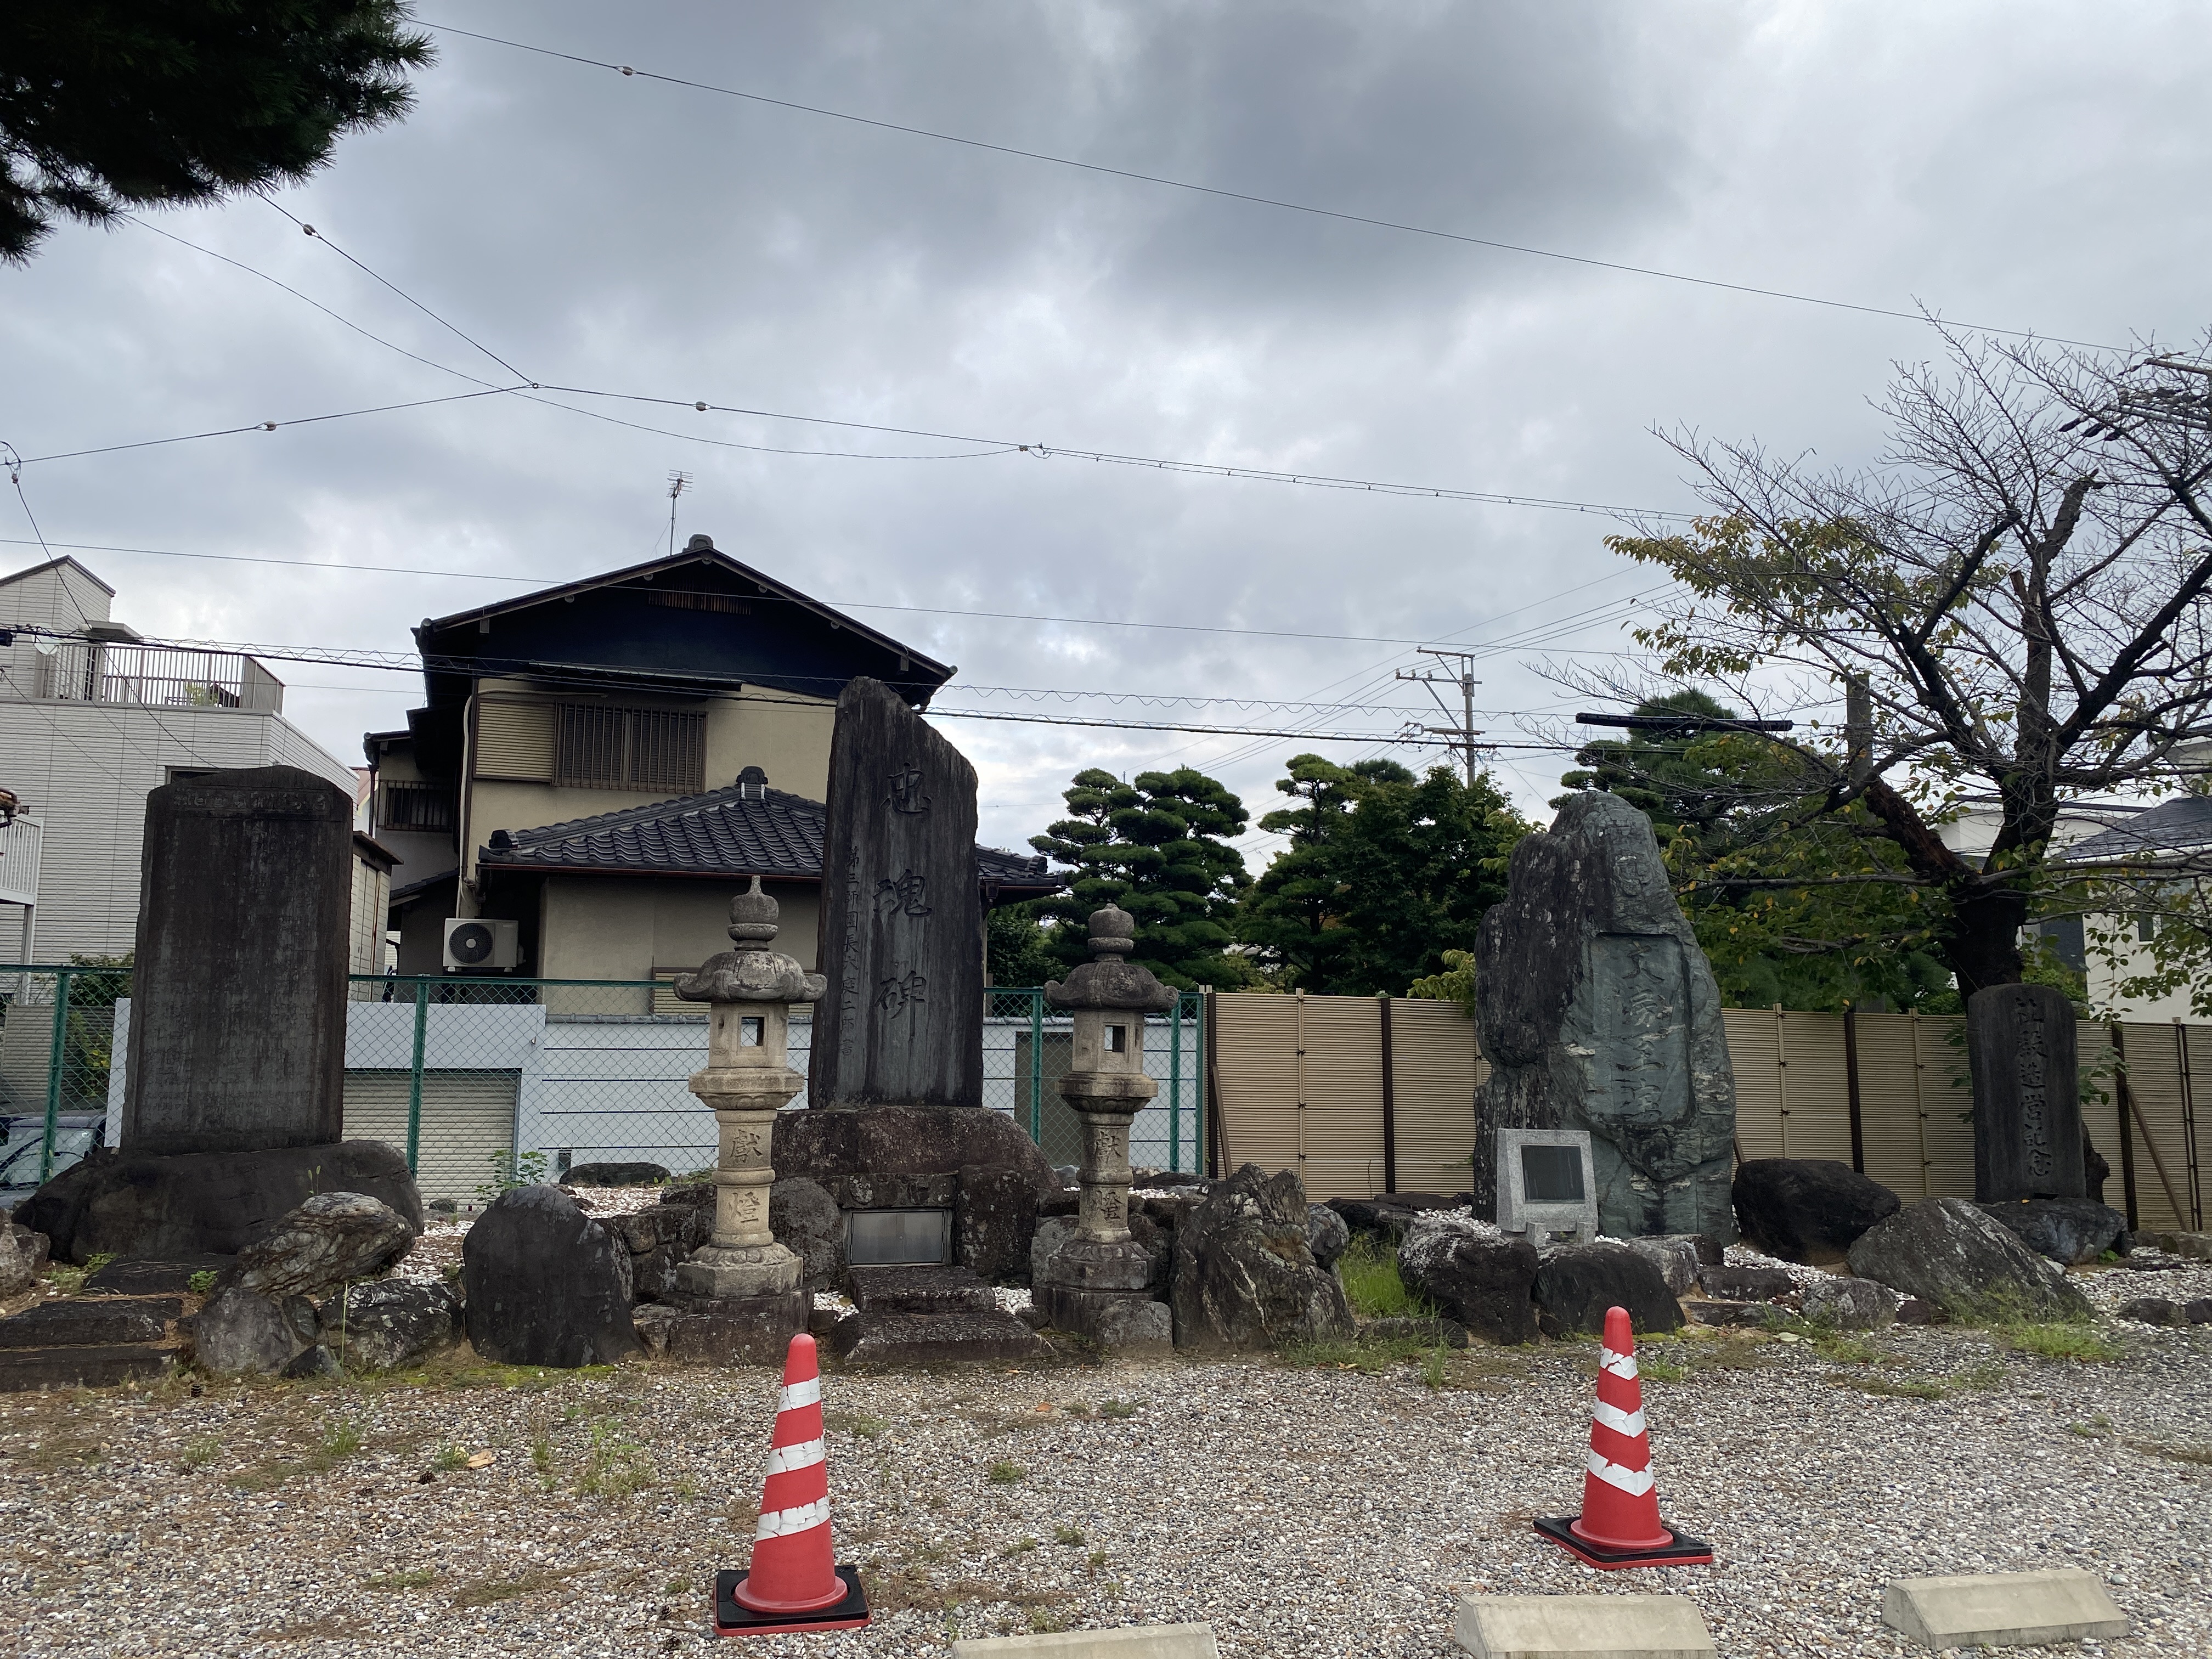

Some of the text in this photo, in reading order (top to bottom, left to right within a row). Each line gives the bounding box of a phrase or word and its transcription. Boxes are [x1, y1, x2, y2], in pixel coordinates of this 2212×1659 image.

[873, 761, 932, 1037] 忠魂碑
[2014, 997, 2053, 1177] 社殿造営記念
